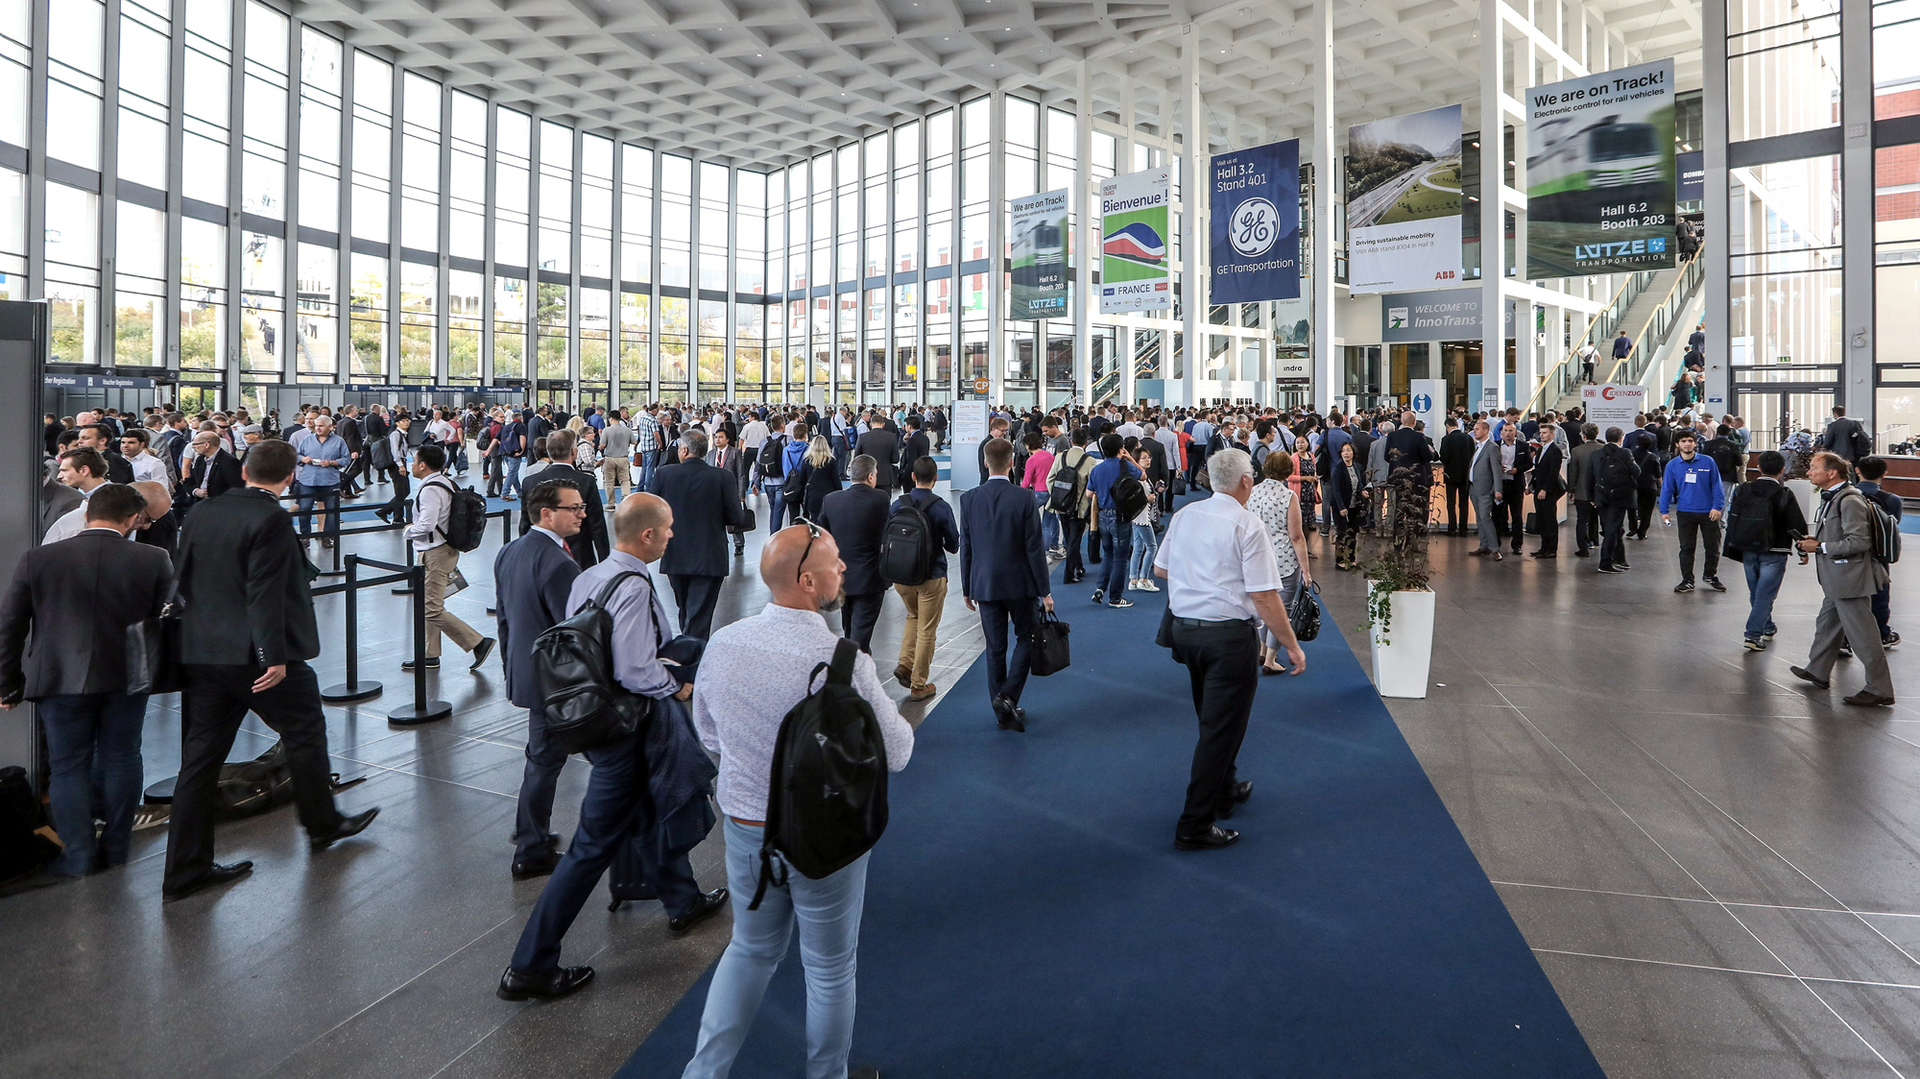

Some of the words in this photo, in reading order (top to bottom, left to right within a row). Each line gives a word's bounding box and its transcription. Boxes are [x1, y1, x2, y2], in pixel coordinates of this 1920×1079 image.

[1534, 94, 1557, 108] We
[1561, 89, 1585, 103] are
[1588, 84, 1609, 98] on
[1613, 70, 1664, 92] Track!
[1534, 106, 1572, 119] Electronic
[1573, 99, 1601, 111] control
[1602, 97, 1614, 106] for
[1615, 94, 1628, 103] rail
[1630, 88, 1665, 101] vehicles
[1217, 165, 1237, 180] Hall
[1239, 162, 1255, 176] 3.2
[1217, 176, 1246, 192] Stand
[1248, 173, 1267, 186] 401
[1014, 204, 1024, 212] We
[1024, 202, 1034, 210] are
[1045, 194, 1064, 206] Track!
[1103, 193, 1162, 213] Bienvenue
[1164, 188, 1168, 202] !
[1601, 204, 1624, 217] Hall
[1628, 202, 1648, 214] 6.2
[1601, 218, 1638, 230] Booth
[1642, 214, 1666, 226] 203
[1377, 235, 1410, 244] sustainable
[1410, 232, 1435, 240] mobility
[1216, 265, 1228, 275] GE
[1230, 258, 1294, 273] Transportation
[1576, 254, 1666, 268] TRANSPORTATION
[1434, 270, 1455, 280] ABB
[1118, 284, 1150, 295] FRANCE
[1415, 302, 1462, 314] WELCOME
[1464, 302, 1478, 311] TO
[1414, 314, 1476, 328] InnoTrans
[53, 377, 76, 386] Registration
[116, 379, 134, 387] Registration
[974, 381, 988, 390] CP
[1584, 389, 1596, 398] DB
